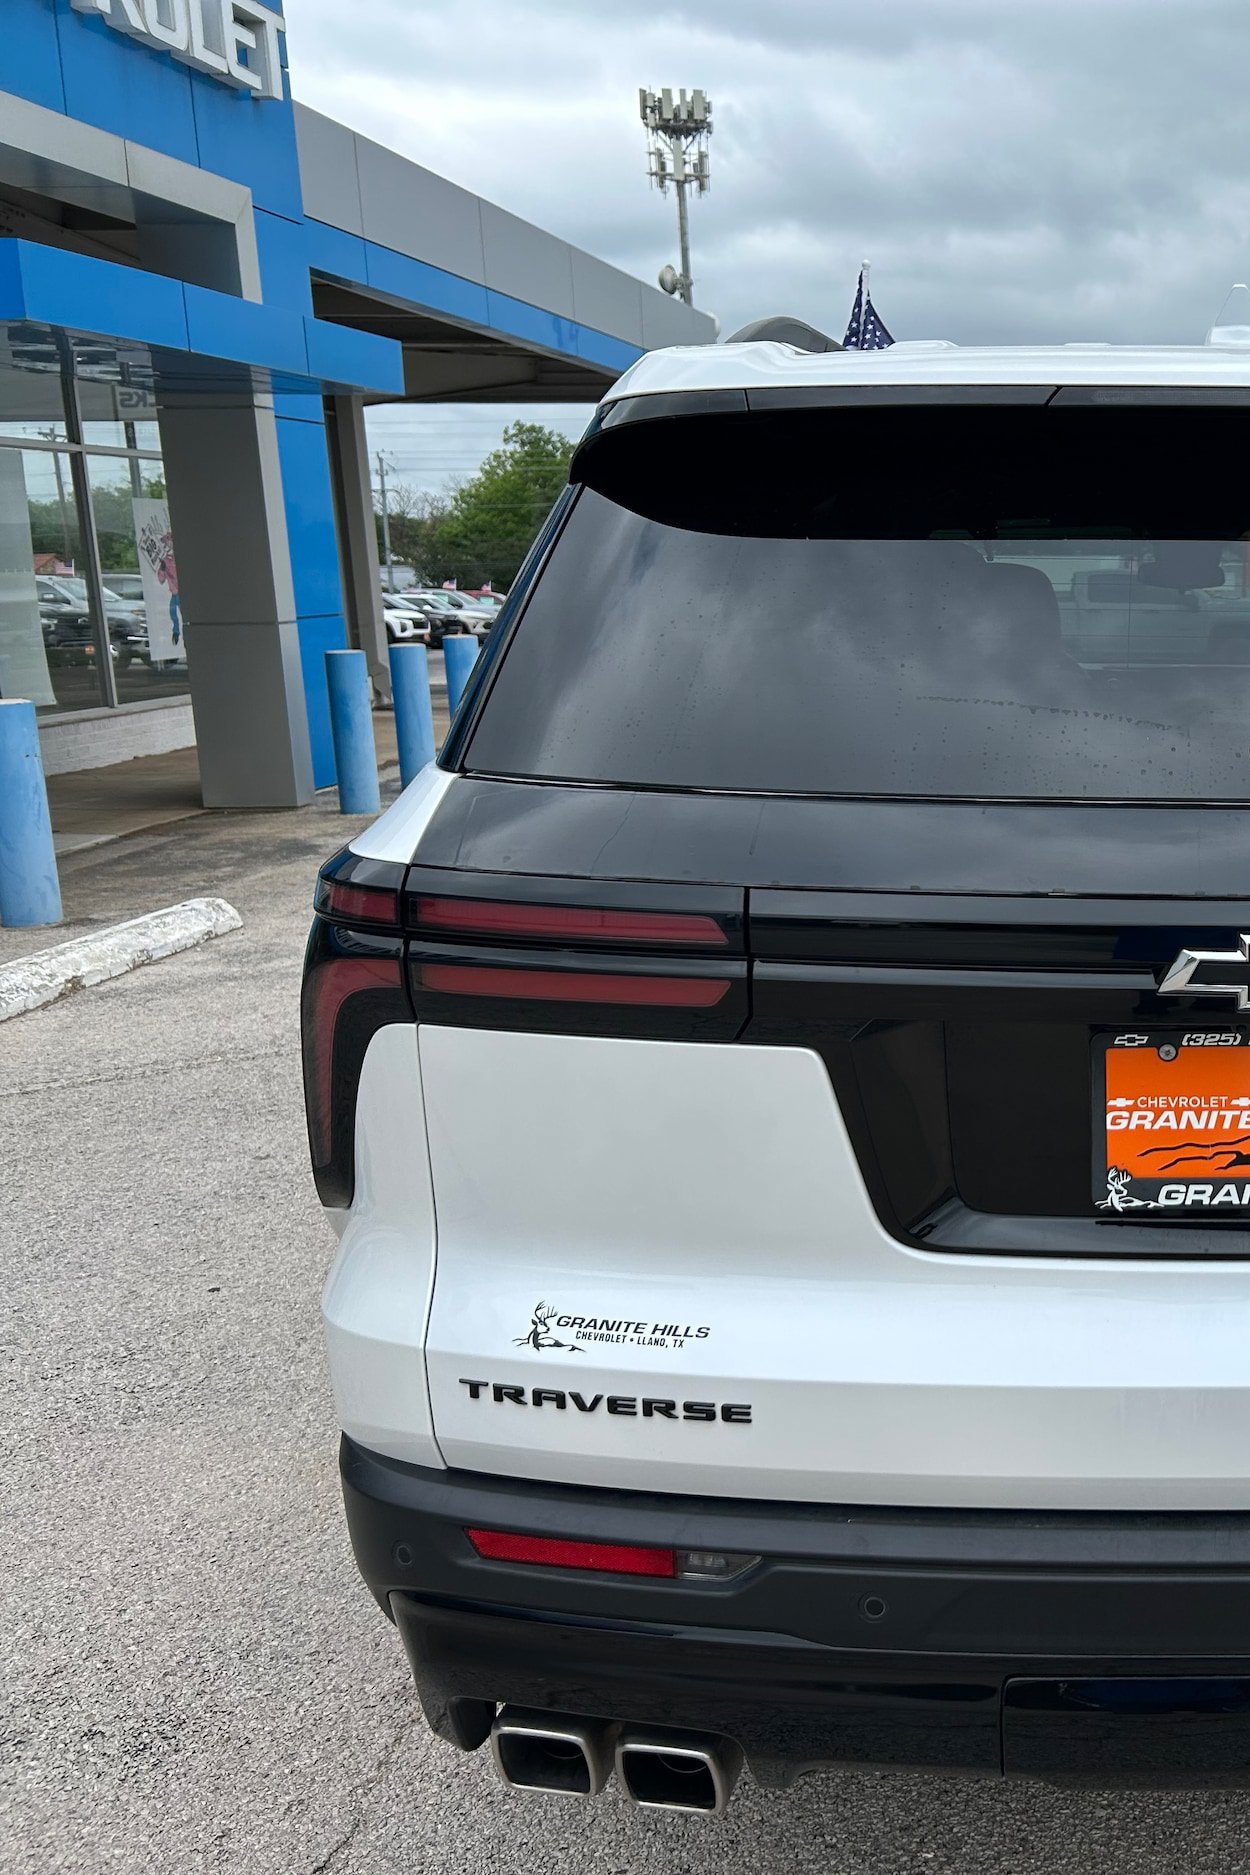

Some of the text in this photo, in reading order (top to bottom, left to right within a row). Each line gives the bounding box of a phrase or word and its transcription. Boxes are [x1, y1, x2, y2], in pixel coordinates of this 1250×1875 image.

[1181, 1033, 1242, 1046] (325)
[1137, 1096, 1229, 1109] CHEVROLET
[556, 1315, 711, 1339] GRANITE HILLS
[575, 1330, 685, 1349] CHEVROLET LLANO, TX
[458, 1378, 753, 1423] TRAVERSE
